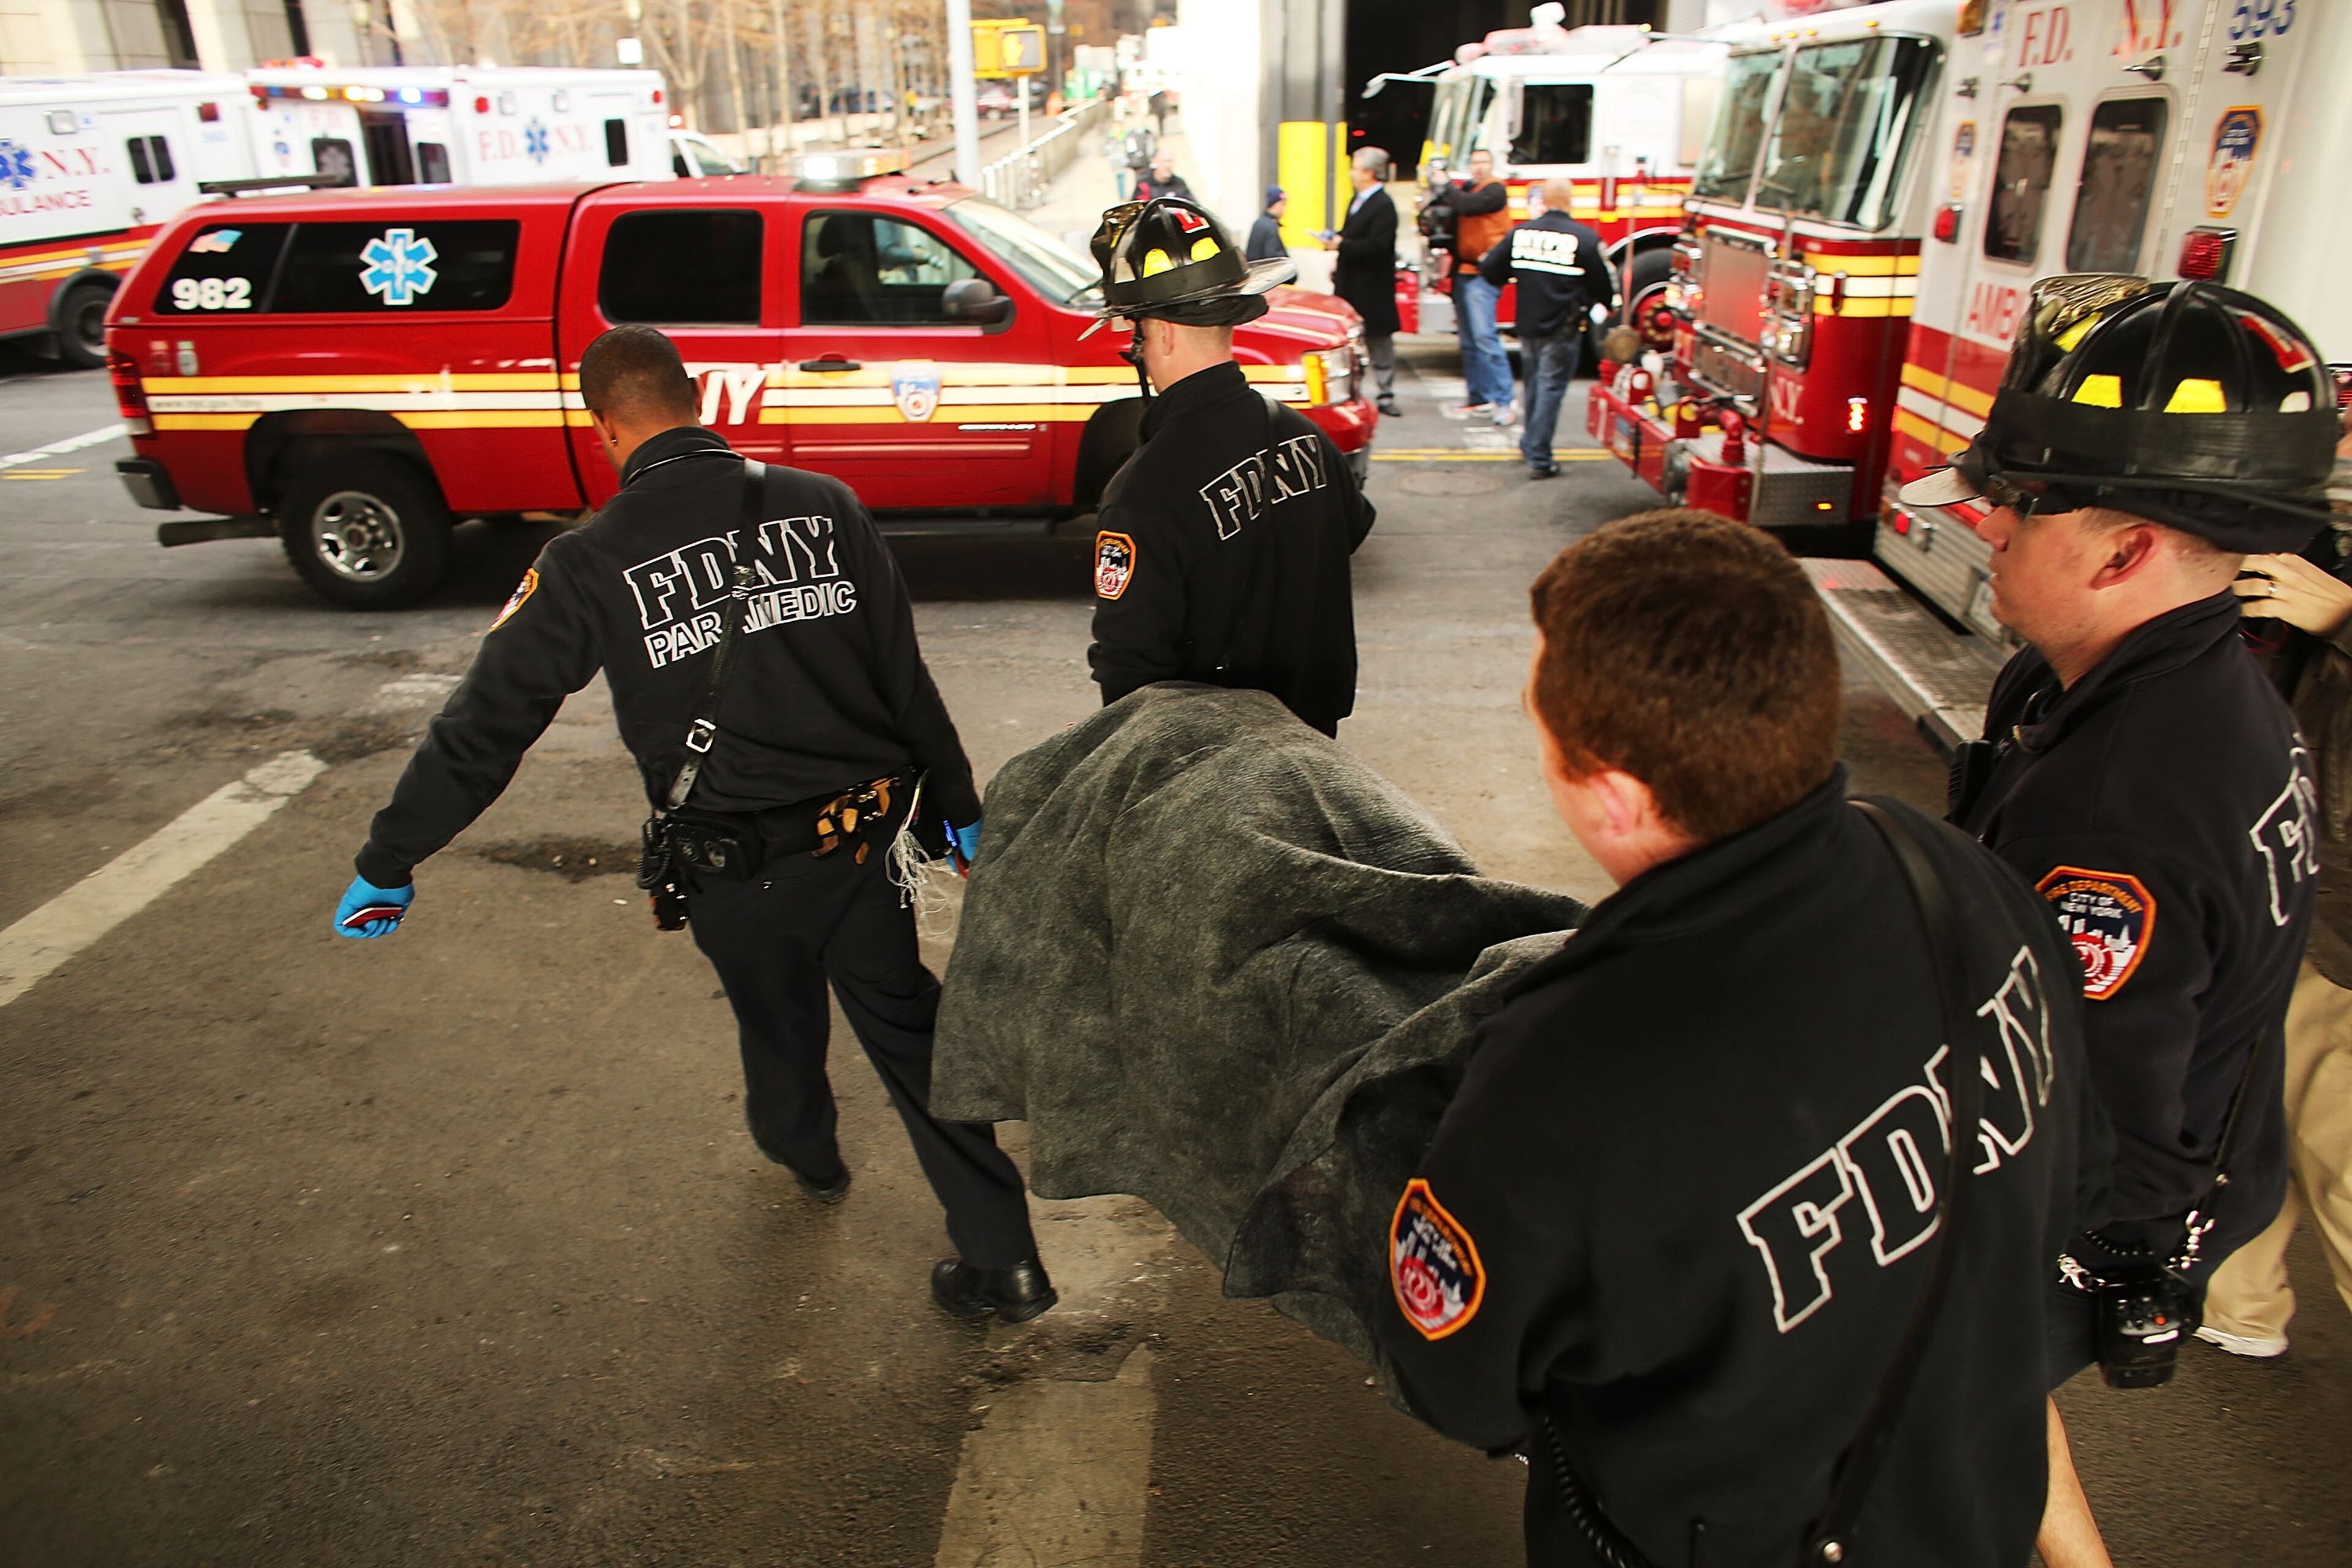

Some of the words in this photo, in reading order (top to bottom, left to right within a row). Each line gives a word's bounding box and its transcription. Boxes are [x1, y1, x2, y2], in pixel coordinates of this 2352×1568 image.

[0, 190, 93, 216] ULANCE
[172, 277, 252, 310] 982
[1199, 434, 1328, 541] FDNY
[622, 516, 839, 630] FDNY
[643, 581, 858, 669] PARMEDIC
[1737, 944, 2054, 1333] FDNY
